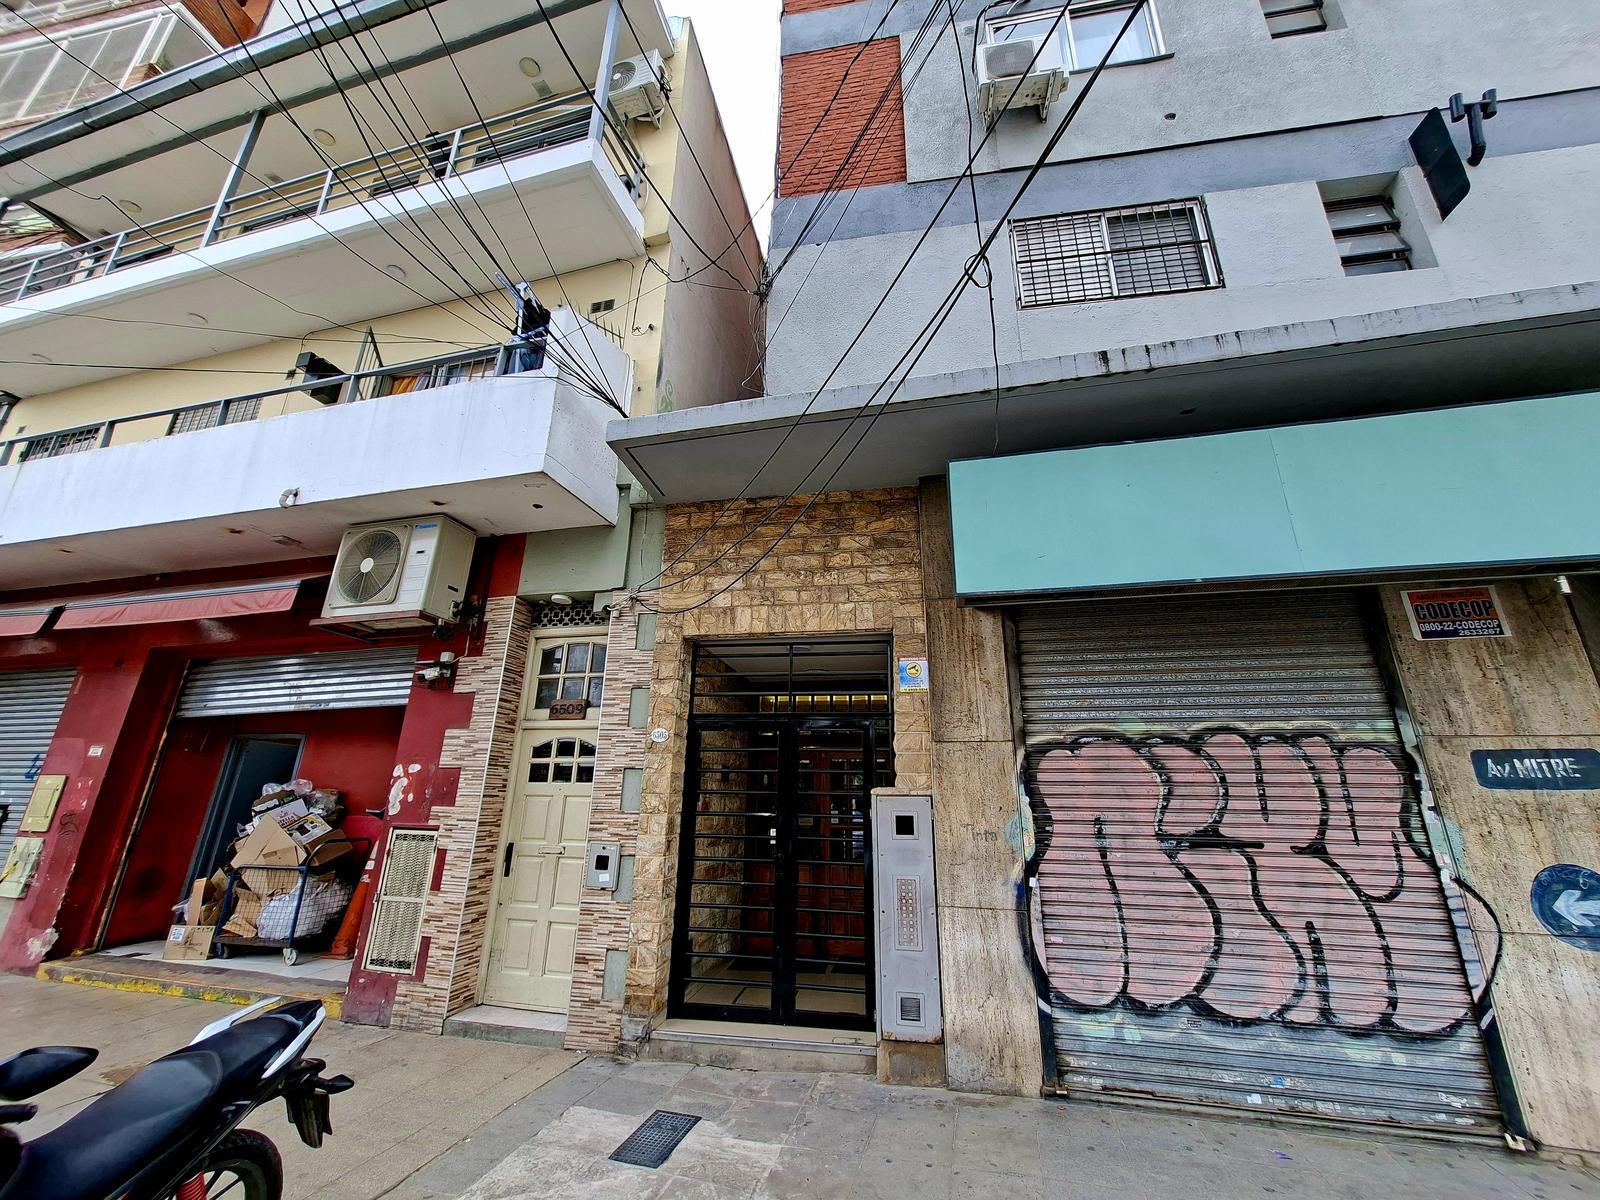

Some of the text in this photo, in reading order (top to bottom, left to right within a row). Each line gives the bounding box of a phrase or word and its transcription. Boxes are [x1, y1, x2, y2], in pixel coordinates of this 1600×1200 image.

[1413, 600, 1493, 620] CODECOP
[1420, 620, 1499, 632] 0800-22-CODECOP
[1458, 628, 1500, 636] 2633267
[551, 703, 584, 715] 6509
[1513, 758, 1582, 778] MITRE
